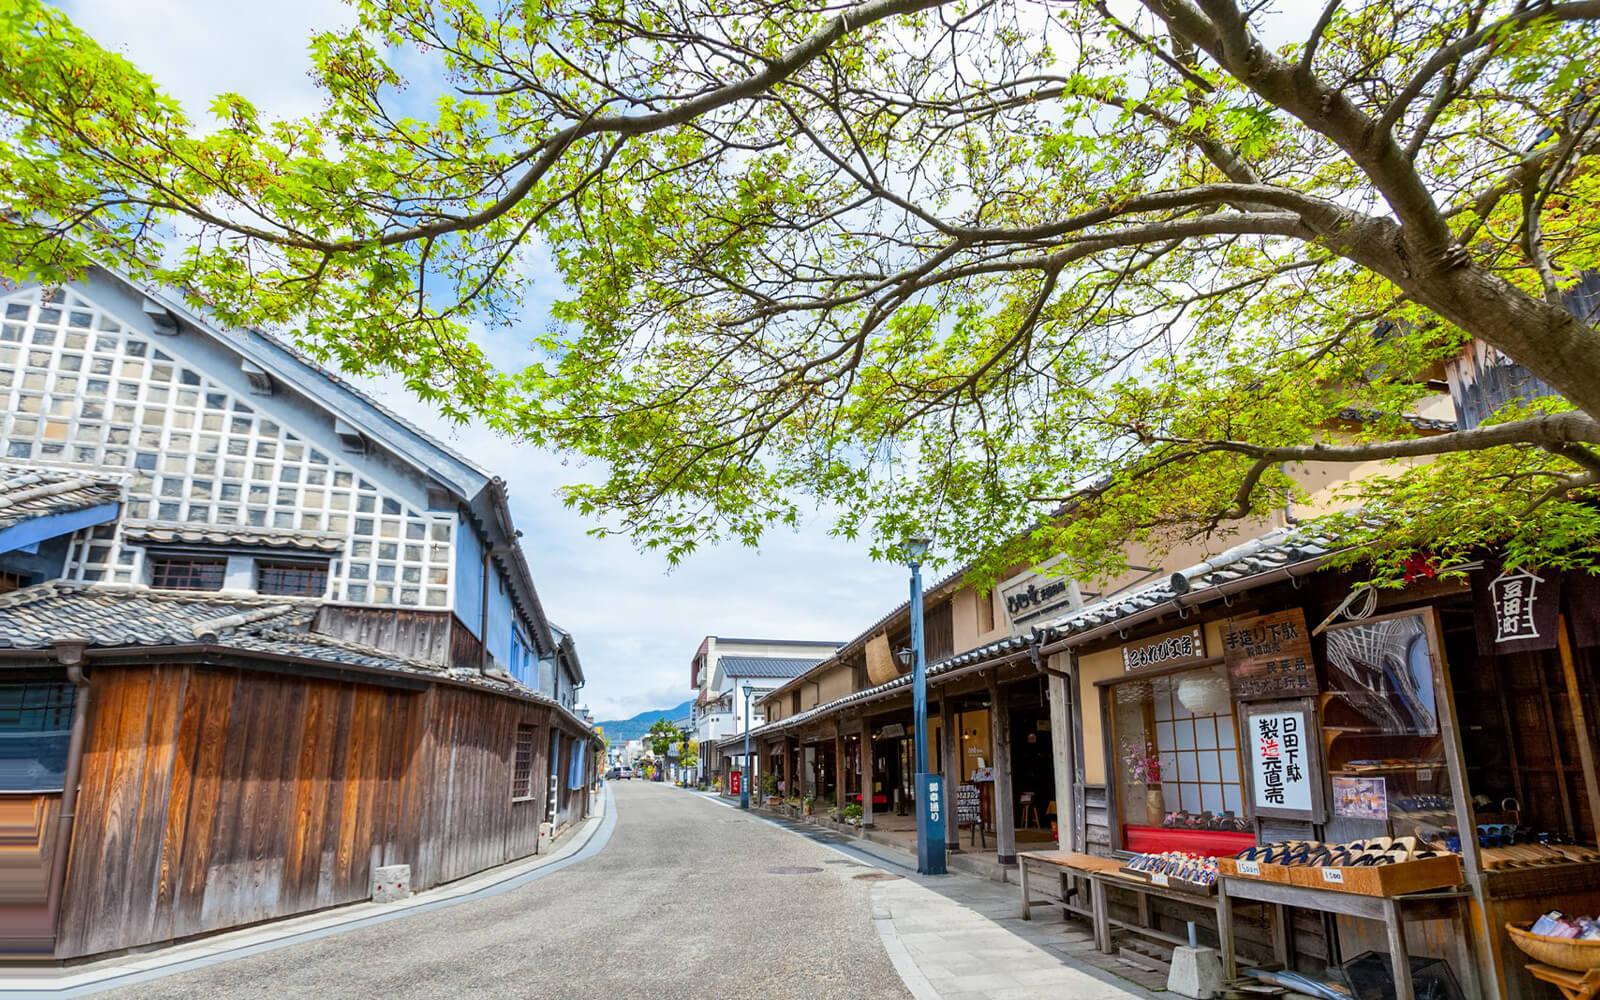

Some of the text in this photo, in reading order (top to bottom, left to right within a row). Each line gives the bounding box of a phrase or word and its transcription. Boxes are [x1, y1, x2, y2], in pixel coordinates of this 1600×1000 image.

[1503, 580, 1523, 633] 豆田町
[1129, 635, 1192, 668] こもれび工房
[1226, 622, 1298, 648] 手造り下駄
[1259, 718, 1284, 804] 製造元直売
[1283, 717, 1302, 783] 日田下駄
